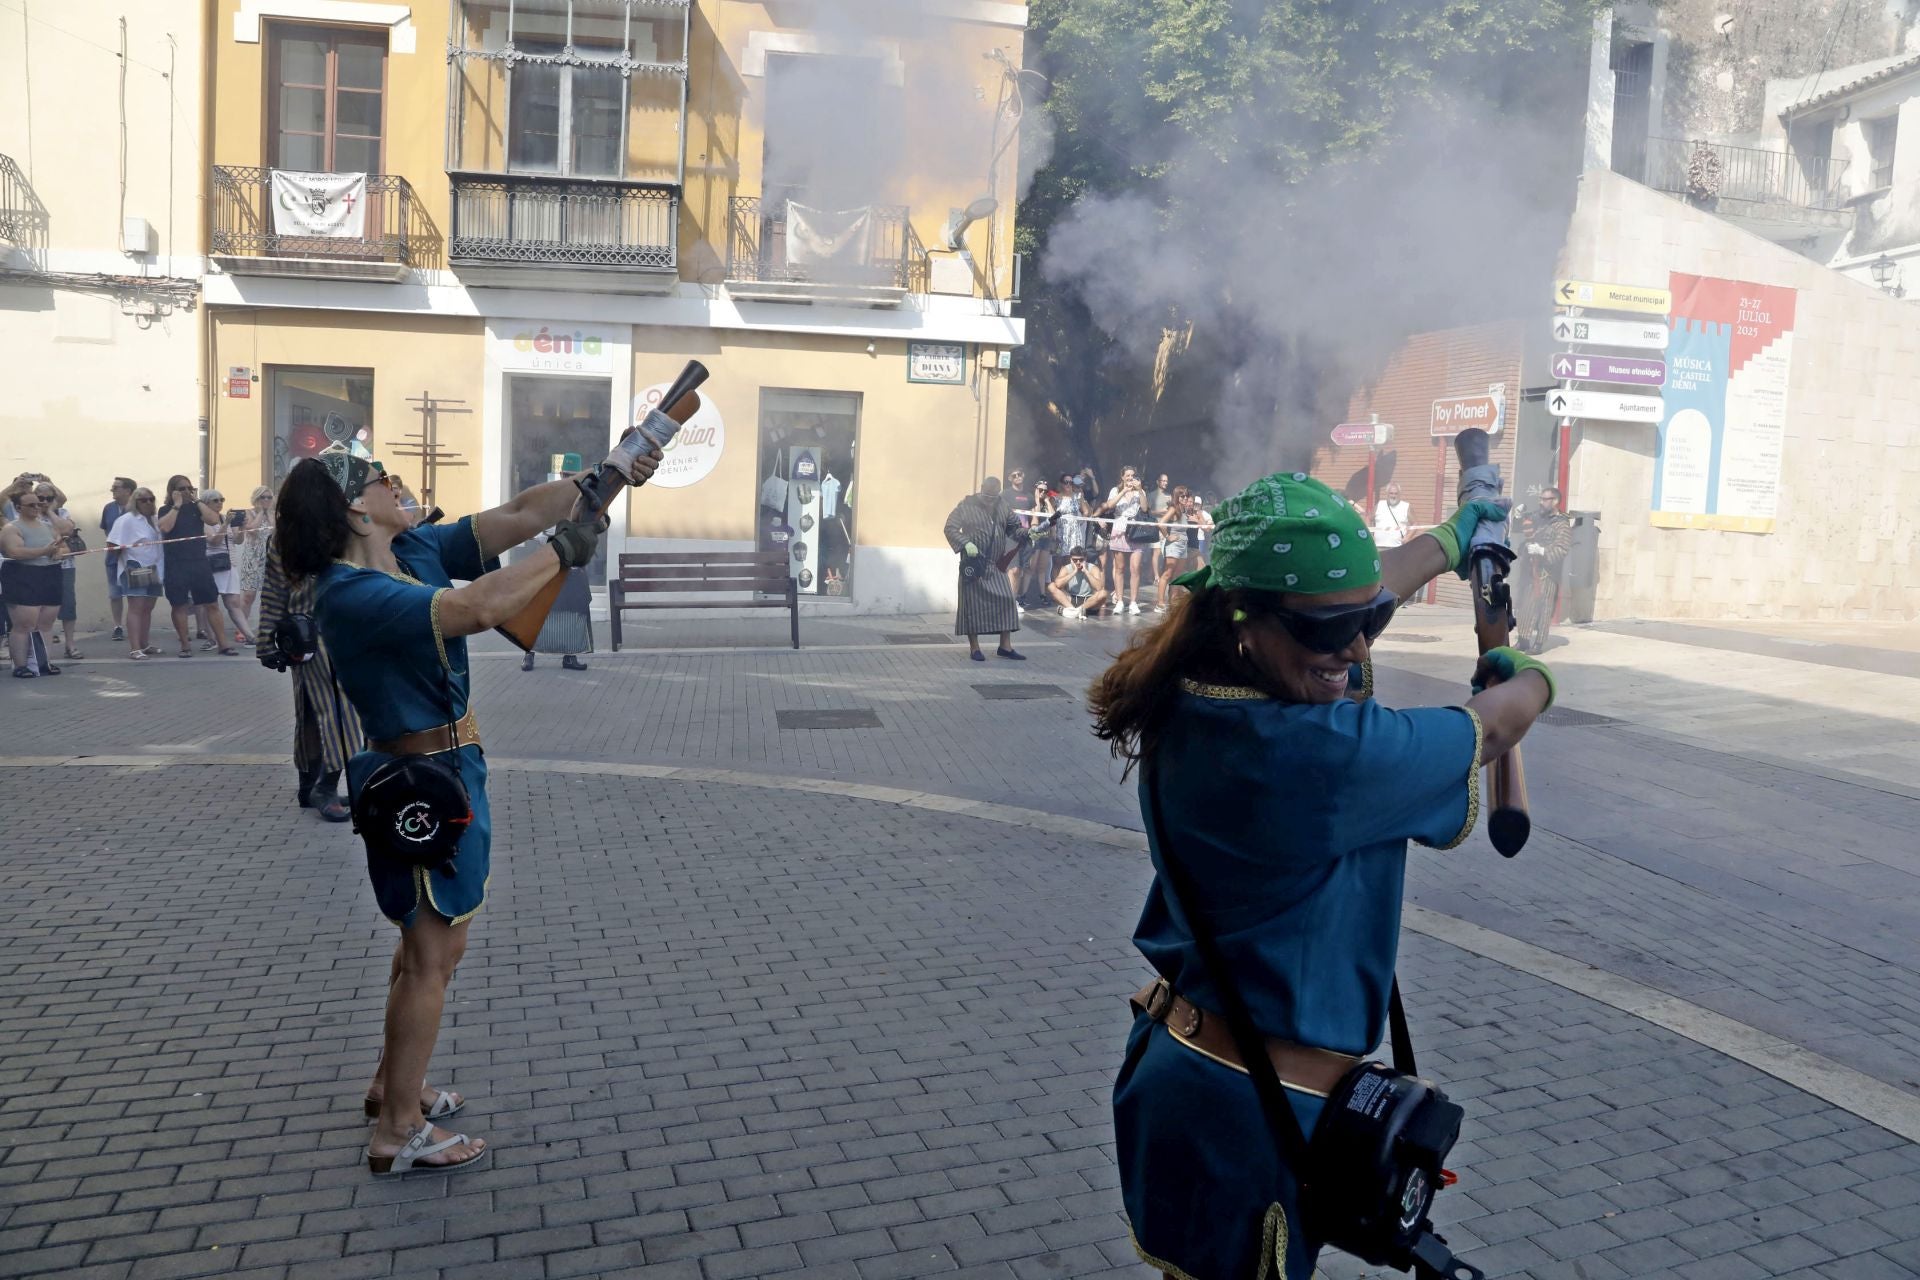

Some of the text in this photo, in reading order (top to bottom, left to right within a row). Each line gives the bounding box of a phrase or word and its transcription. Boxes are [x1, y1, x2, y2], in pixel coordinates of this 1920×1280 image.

[1609, 292, 1665, 306] Mercat municipal
[1736, 309, 1772, 324] JULIOL
[1736, 326, 1758, 338] 2025
[513, 326, 602, 356] dénia
[532, 356, 585, 370] única
[922, 363, 951, 373] DIANA
[1673, 356, 1712, 371] MÚSICA
[1608, 365, 1662, 379] Museu etnològic
[1680, 370, 1712, 382] CASTELL
[1672, 379, 1697, 391] DÉNIA
[1435, 402, 1489, 424] Toy Planet
[1619, 402, 1657, 414] Ajuntament
